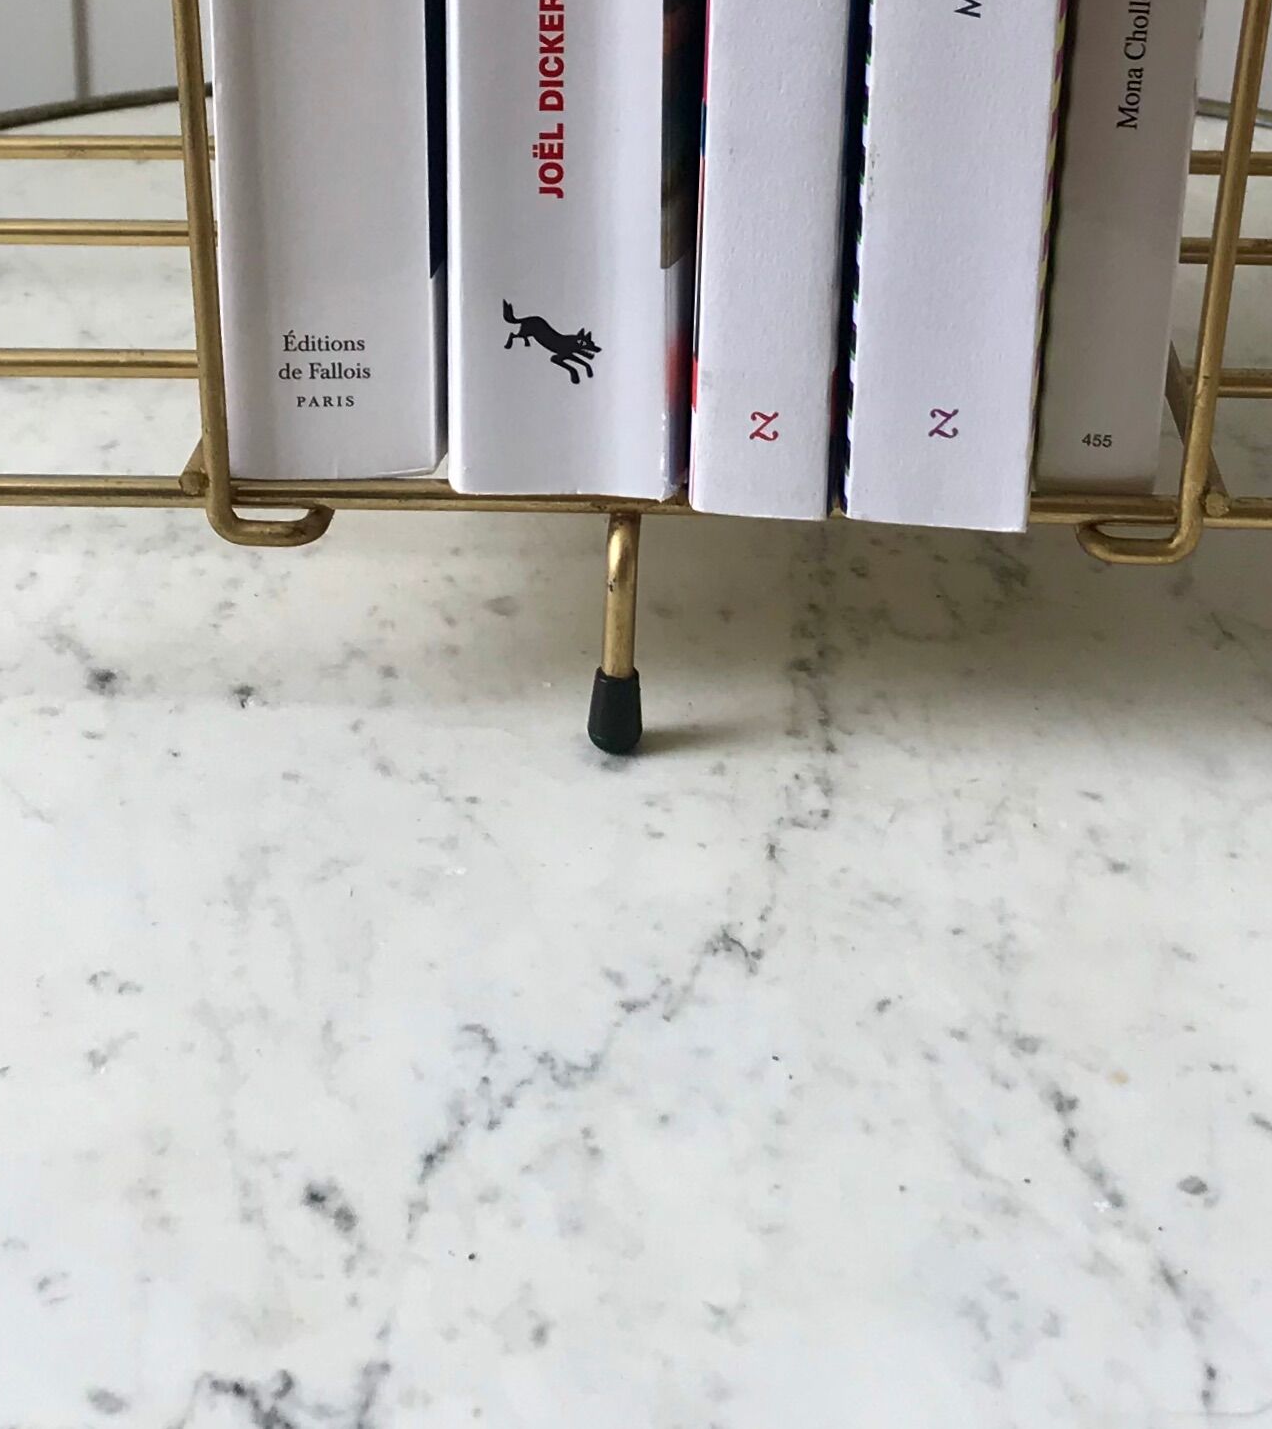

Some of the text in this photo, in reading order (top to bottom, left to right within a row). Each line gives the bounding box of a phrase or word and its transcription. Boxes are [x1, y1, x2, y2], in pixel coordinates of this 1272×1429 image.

[1115, 67, 1144, 131] Mona
[532, 122, 565, 199] JOËL
[282, 330, 365, 353] Éditions
[278, 362, 371, 380] de Fallois
[297, 396, 355, 408] PARIS
[1081, 433, 1113, 448] 455
